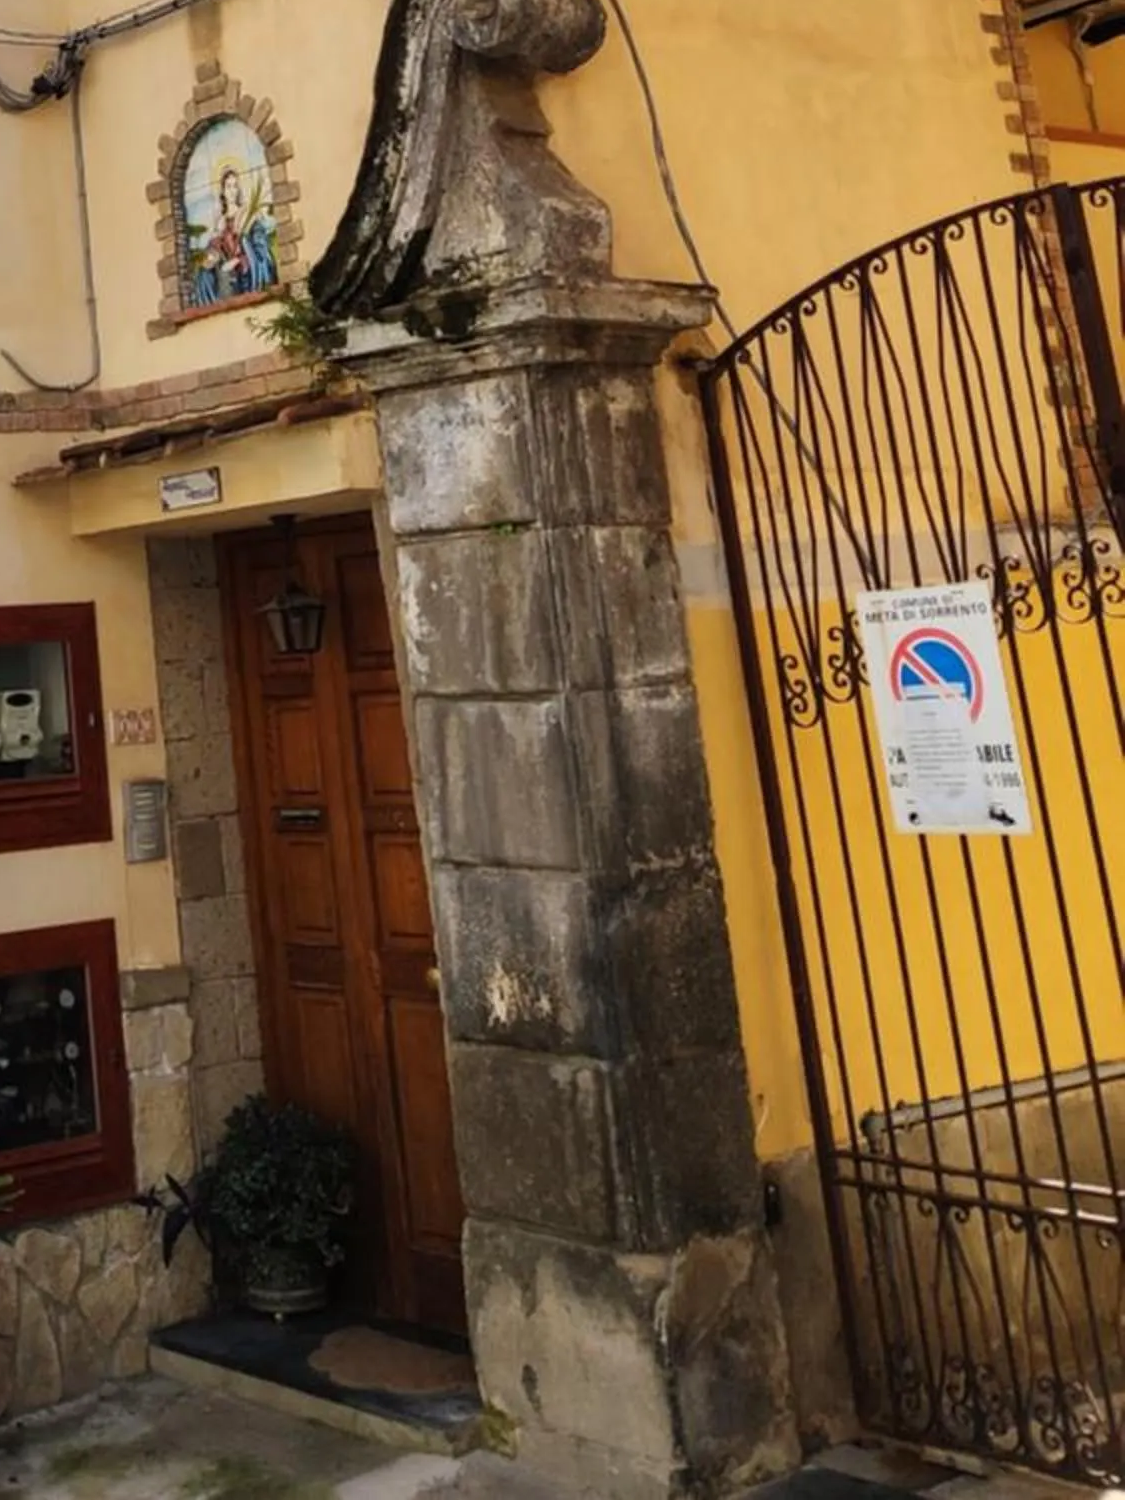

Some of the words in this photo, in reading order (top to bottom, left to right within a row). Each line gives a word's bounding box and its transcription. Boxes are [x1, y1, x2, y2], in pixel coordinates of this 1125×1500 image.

[865, 610, 900, 623] META
[903, 608, 916, 621] DI
[920, 601, 987, 620] SORRENTO
